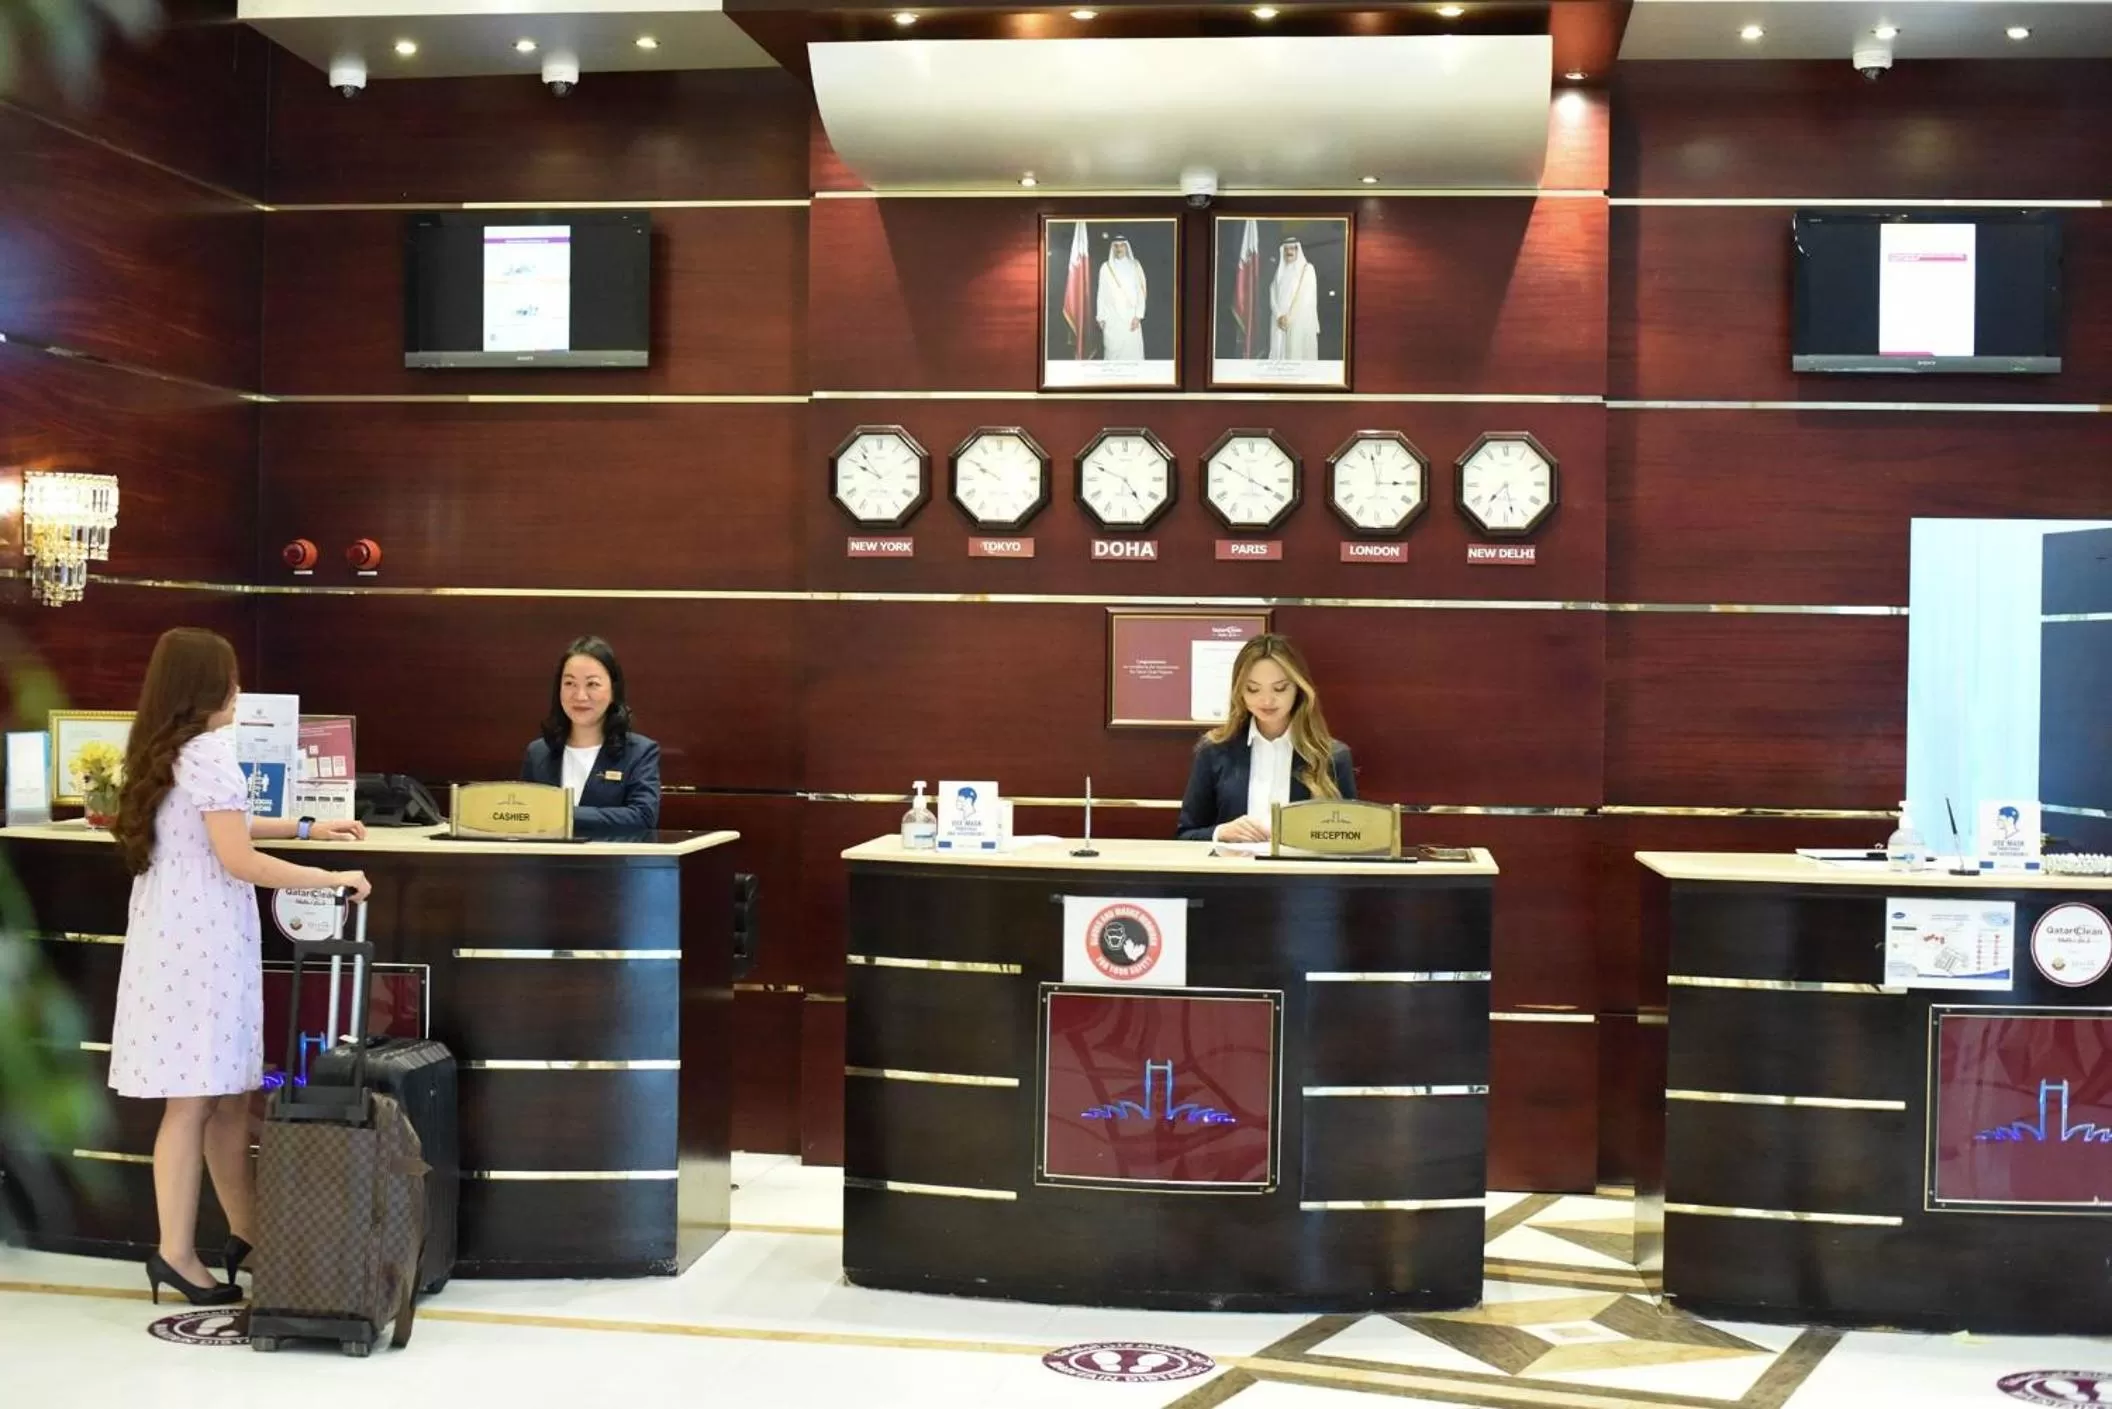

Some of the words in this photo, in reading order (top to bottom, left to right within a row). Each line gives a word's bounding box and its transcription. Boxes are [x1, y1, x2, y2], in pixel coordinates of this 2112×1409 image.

[850, 541, 877, 552] NEW
[879, 542, 912, 553] YORK
[982, 541, 1021, 553] TOKYO
[1094, 541, 1154, 557] DOHA
[1231, 544, 1267, 555] PARIS
[1349, 545, 1399, 557] LONDON
[1468, 547, 1496, 559] NEW
[1499, 548, 1536, 560] DELHI
[492, 811, 530, 822] CASHIER
[1310, 830, 1361, 841] RECEPTION
